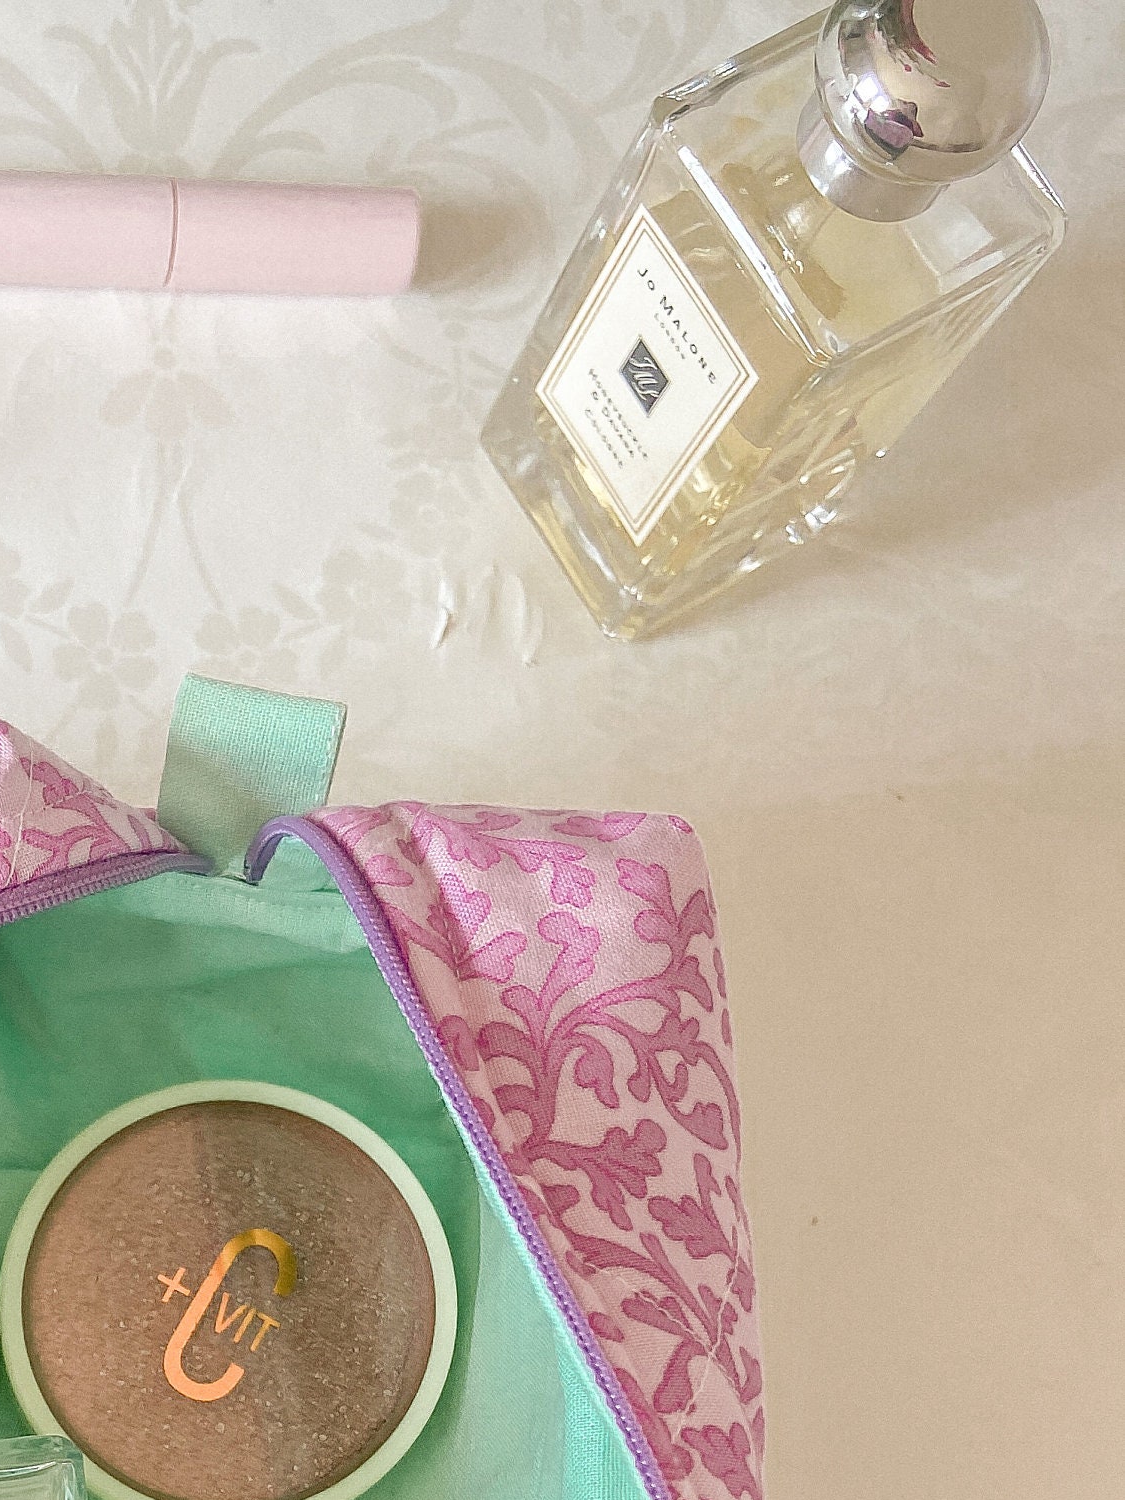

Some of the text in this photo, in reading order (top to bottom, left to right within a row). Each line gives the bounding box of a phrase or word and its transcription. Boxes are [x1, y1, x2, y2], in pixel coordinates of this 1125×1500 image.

[637, 268, 716, 384] JO MALONE
[214, 1292, 281, 1352] VIT
